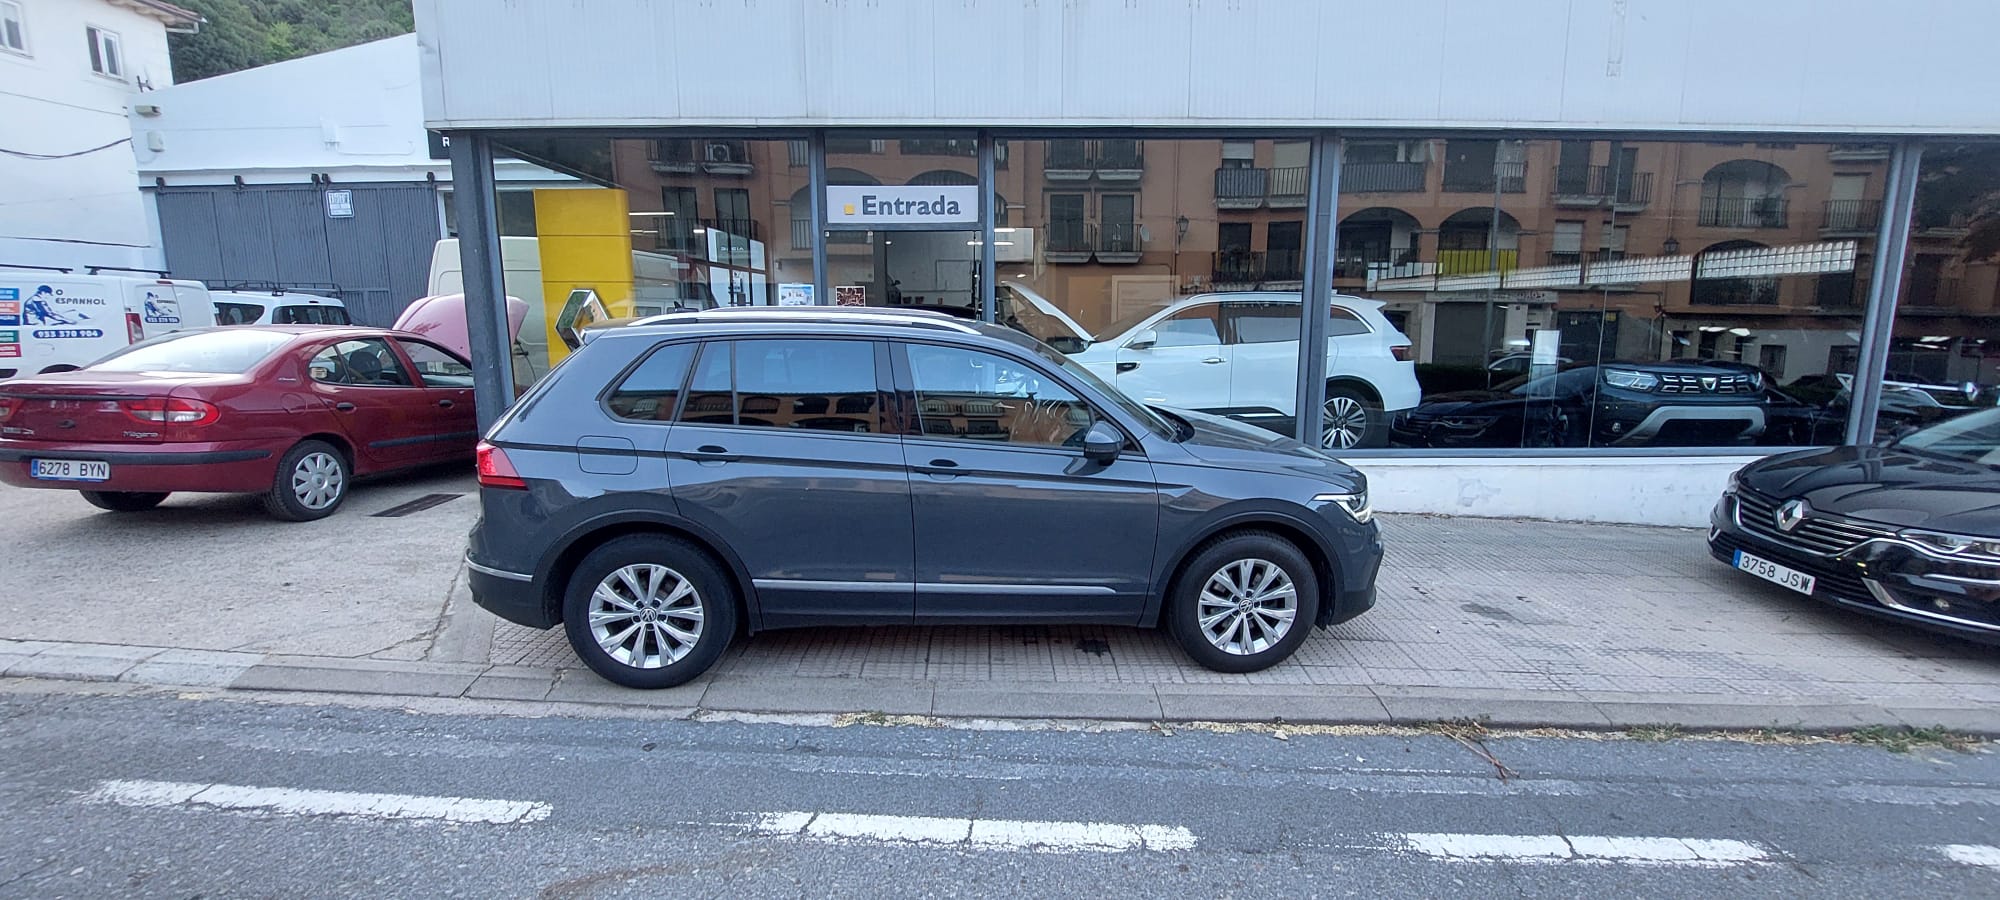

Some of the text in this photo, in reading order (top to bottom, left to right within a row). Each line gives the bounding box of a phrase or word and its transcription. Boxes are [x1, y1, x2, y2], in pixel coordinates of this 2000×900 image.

[862, 194, 961, 216] Entrada
[55, 297, 107, 305] ESPANHOL
[39, 462, 106, 477] 6278 BYN
[1742, 555, 1811, 592] 3758 JSW
